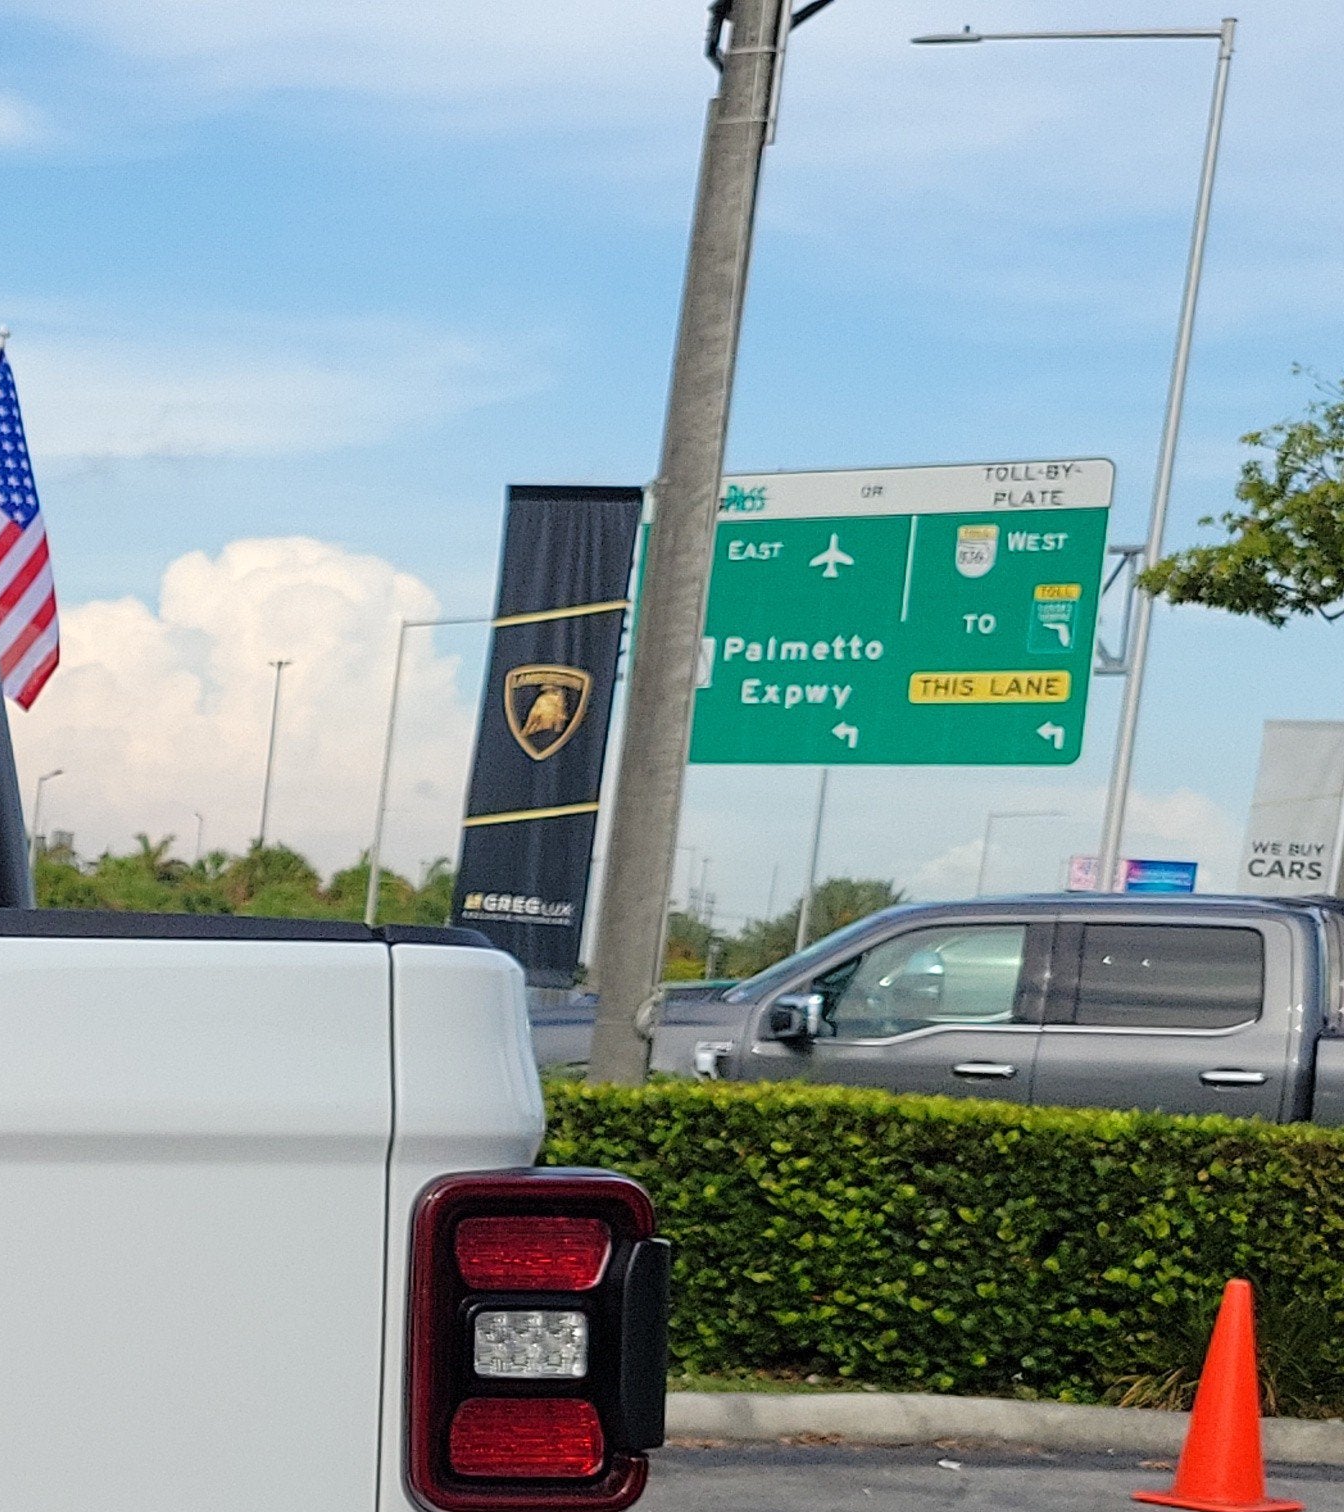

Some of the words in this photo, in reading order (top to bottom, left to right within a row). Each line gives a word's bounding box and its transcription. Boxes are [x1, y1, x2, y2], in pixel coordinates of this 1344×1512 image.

[993, 490, 1064, 507] PLATE
[728, 540, 784, 560] EAST
[1008, 532, 1068, 551] WEST
[963, 613, 996, 634] TO
[723, 634, 884, 662] Palmetto
[741, 678, 852, 710] Expwy
[919, 677, 973, 696] THIS
[989, 677, 1059, 696] LANE
[1252, 841, 1282, 855] WE
[1289, 843, 1324, 856] BUY
[1248, 859, 1322, 880] CARS
